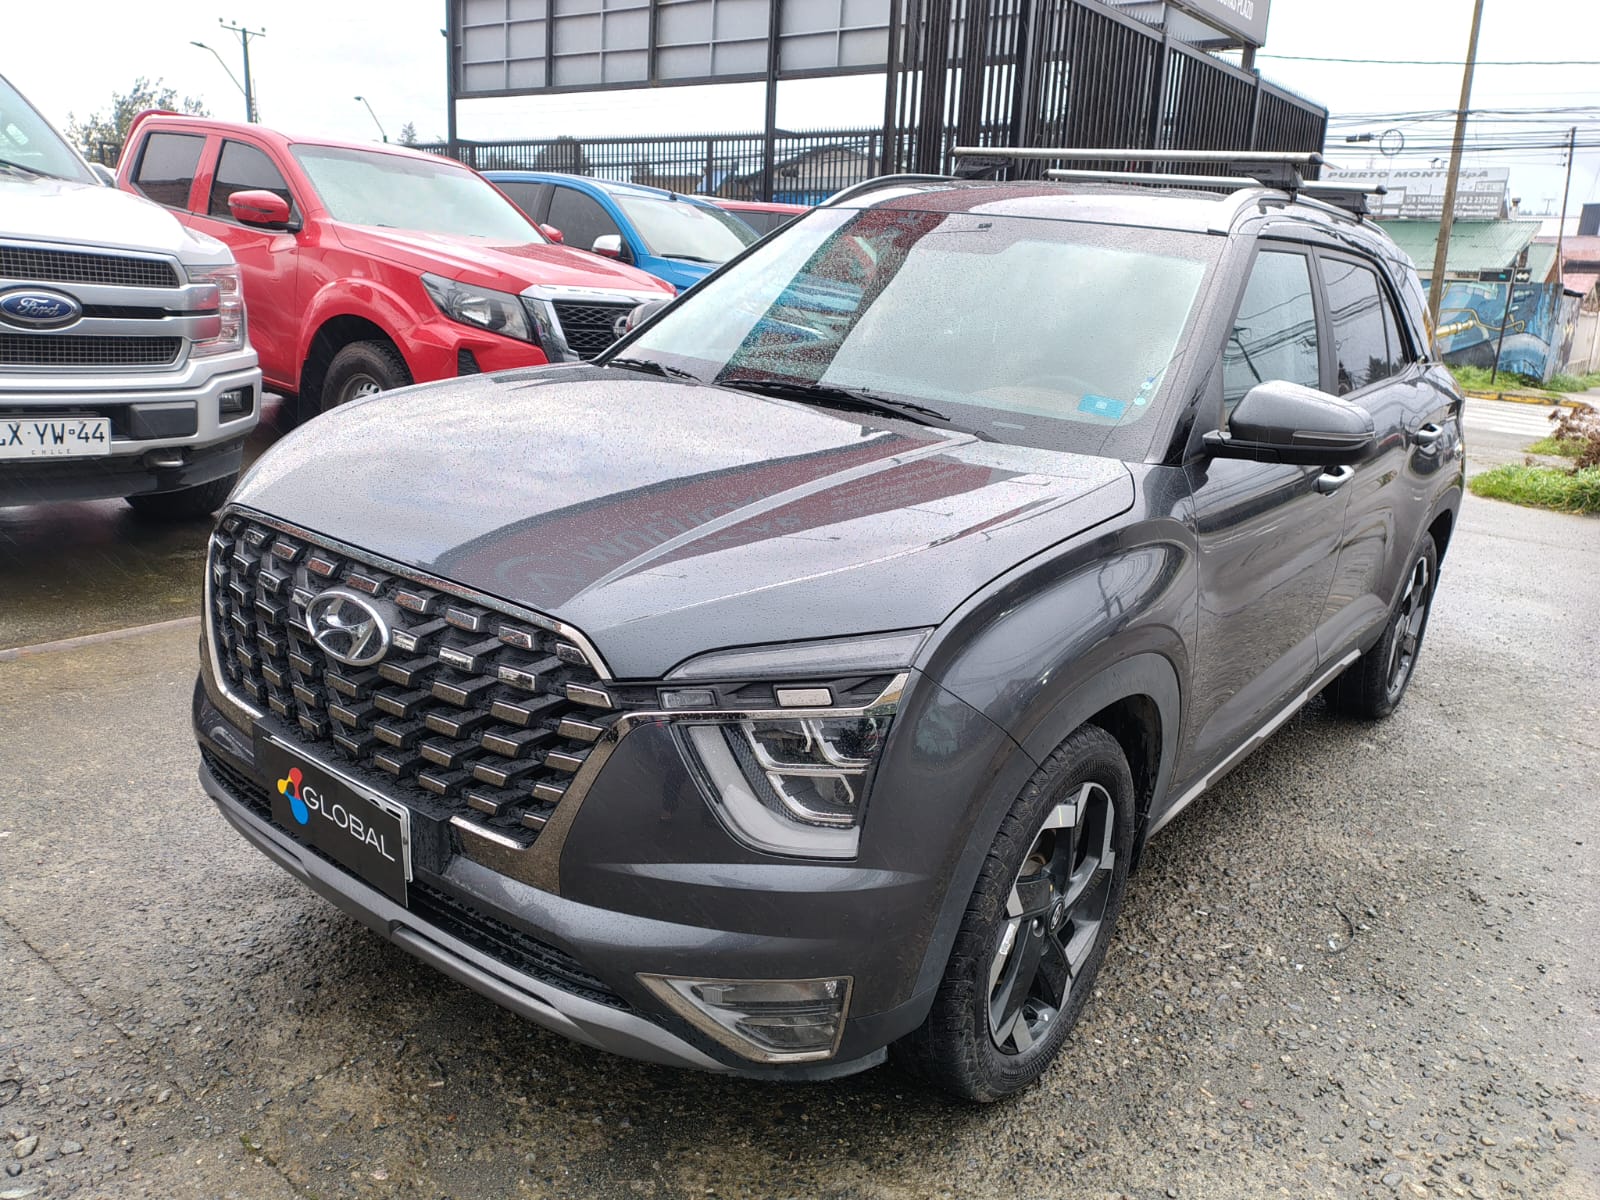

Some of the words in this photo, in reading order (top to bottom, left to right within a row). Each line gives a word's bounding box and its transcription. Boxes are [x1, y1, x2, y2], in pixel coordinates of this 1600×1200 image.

[1327, 171, 1390, 179] PUERTO
[17, 297, 60, 317] Ford
[31, 448, 72, 456] CHILE
[302, 786, 396, 862] GLOBAL
